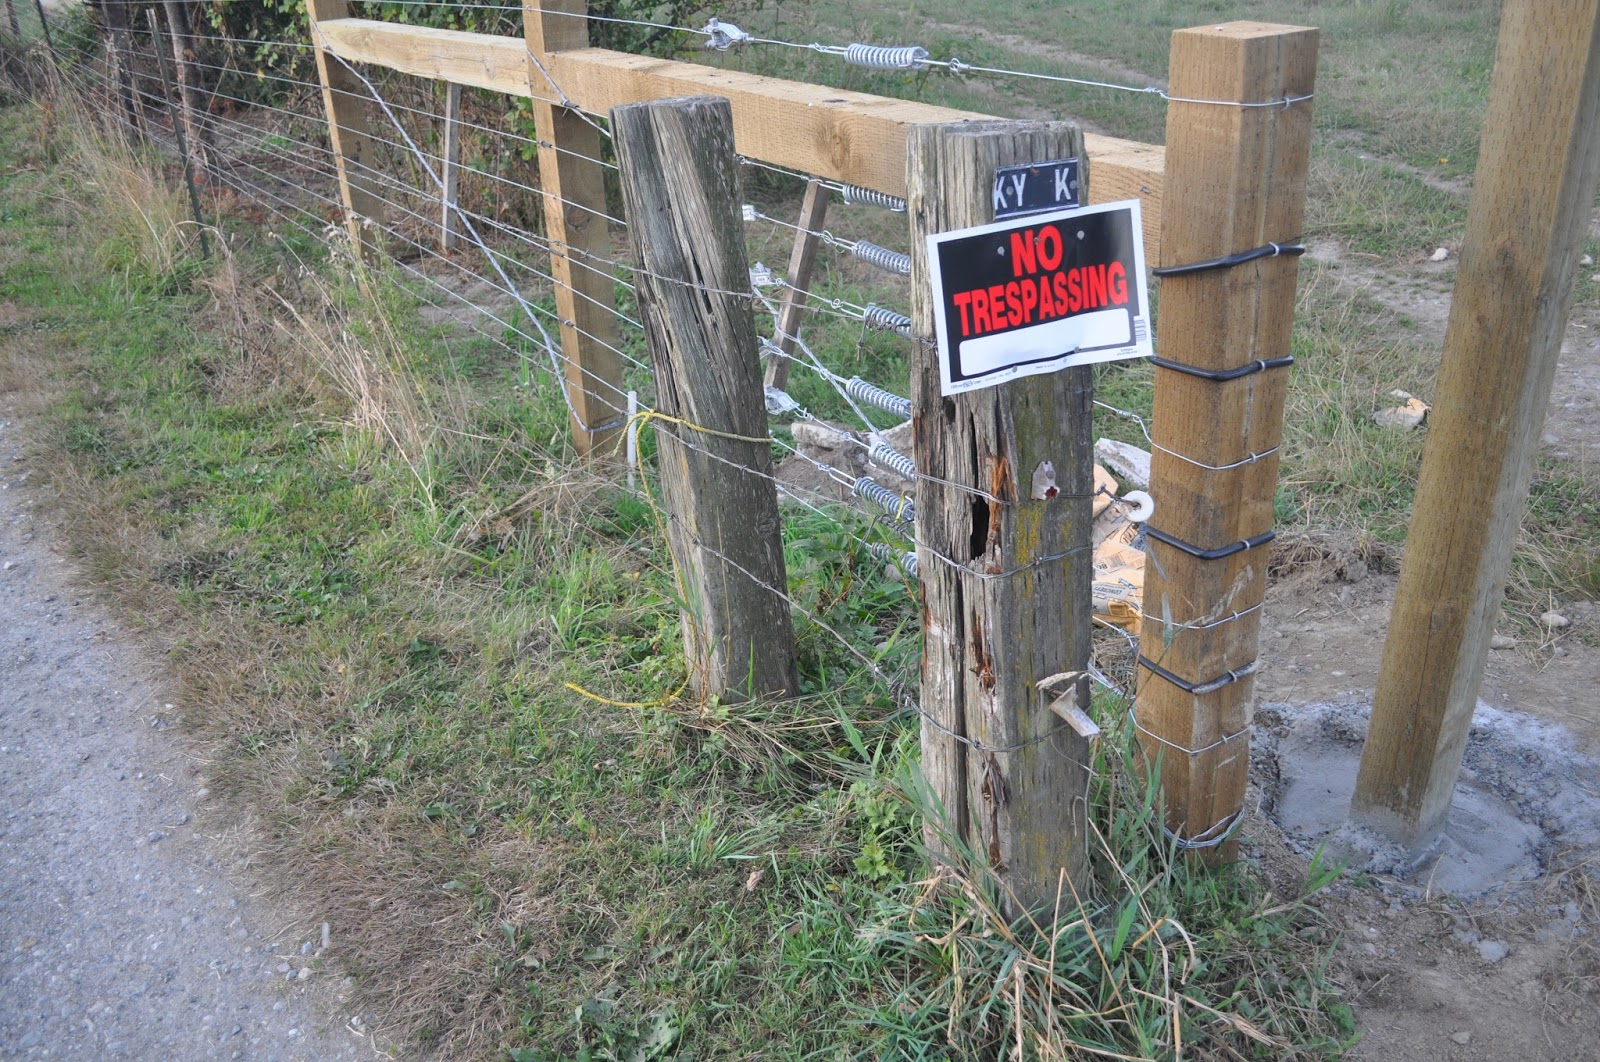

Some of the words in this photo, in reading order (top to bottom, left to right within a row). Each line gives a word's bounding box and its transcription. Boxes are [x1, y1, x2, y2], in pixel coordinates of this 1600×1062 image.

[1055, 168, 1071, 201] K
[1010, 225, 1063, 277] NO
[953, 262, 1128, 336] TRESPASSING
